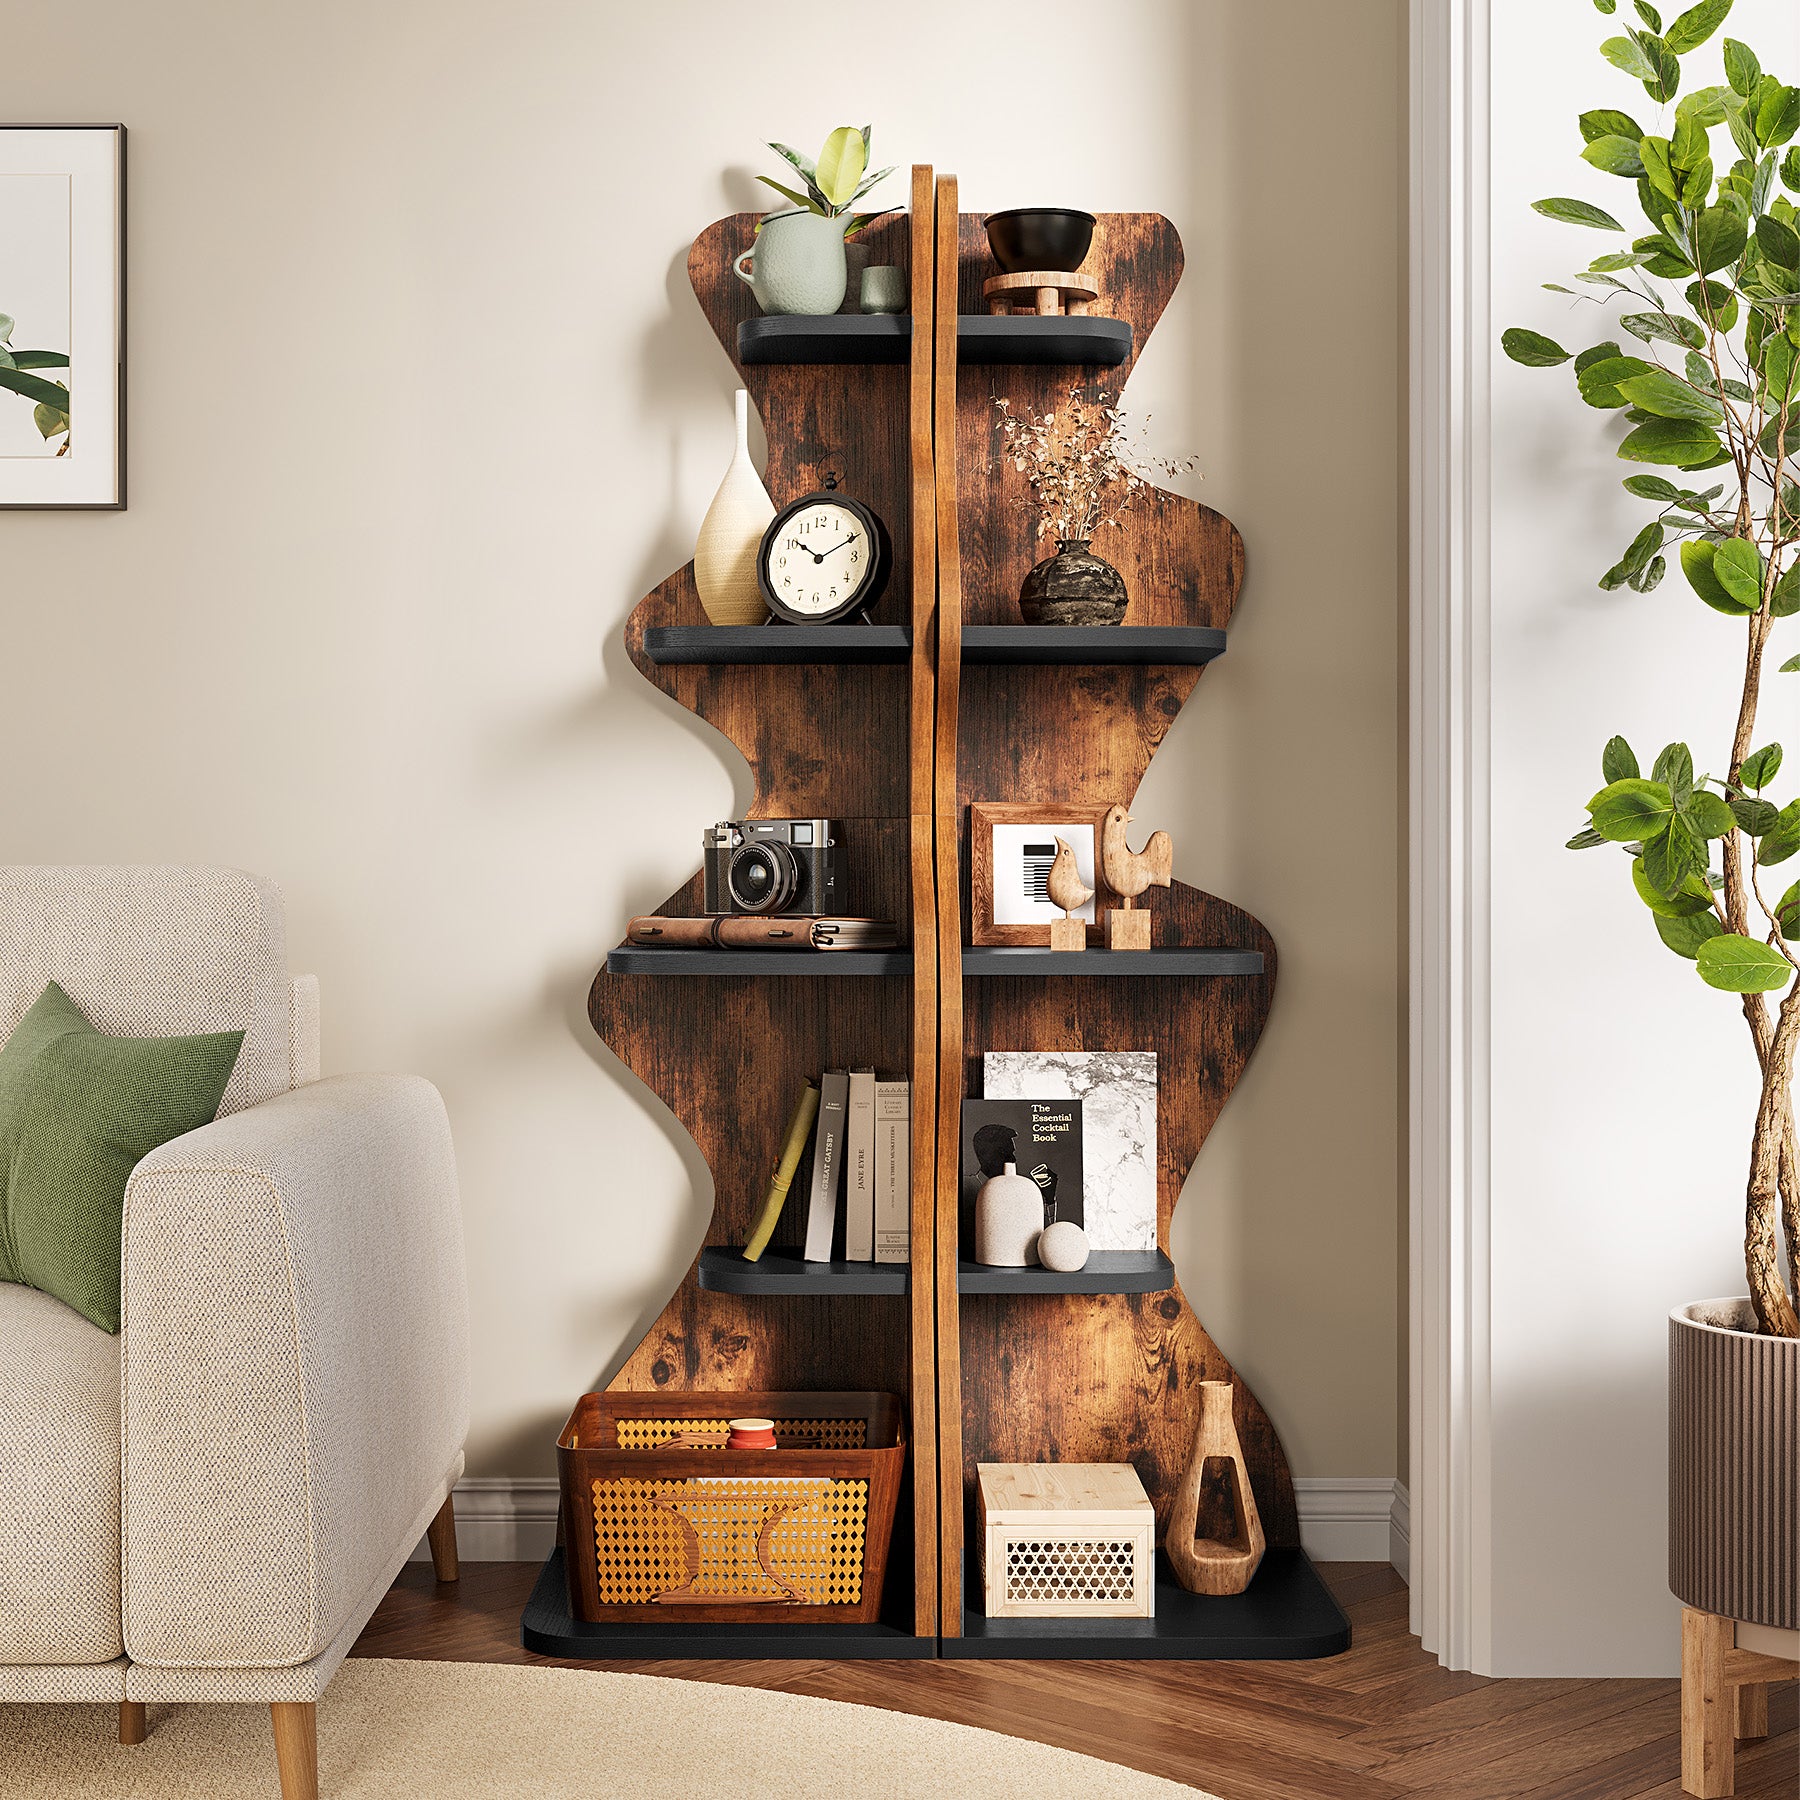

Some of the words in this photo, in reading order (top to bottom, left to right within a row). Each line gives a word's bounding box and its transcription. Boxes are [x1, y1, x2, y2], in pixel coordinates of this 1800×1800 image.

[815, 516, 827, 528] 12
[835, 520, 839, 531] 1
[800, 523, 810, 534] 11
[787, 537, 799, 550] 10
[851, 551, 858, 562] 3
[779, 557, 786, 568] 9
[783, 576, 791, 587] 8
[843, 571, 850, 583] 4
[798, 589, 804, 601] 7
[812, 592, 820, 603] 6
[829, 586, 837, 598] 5
[1031, 1104, 1050, 1113] The
[1032, 1113, 1072, 1122] Essential
[1032, 1123, 1070, 1132] Cocktail
[1032, 1134, 1057, 1142] Book
[824, 1132, 834, 1163] GATSBY
[822, 1163, 831, 1190] GREAT
